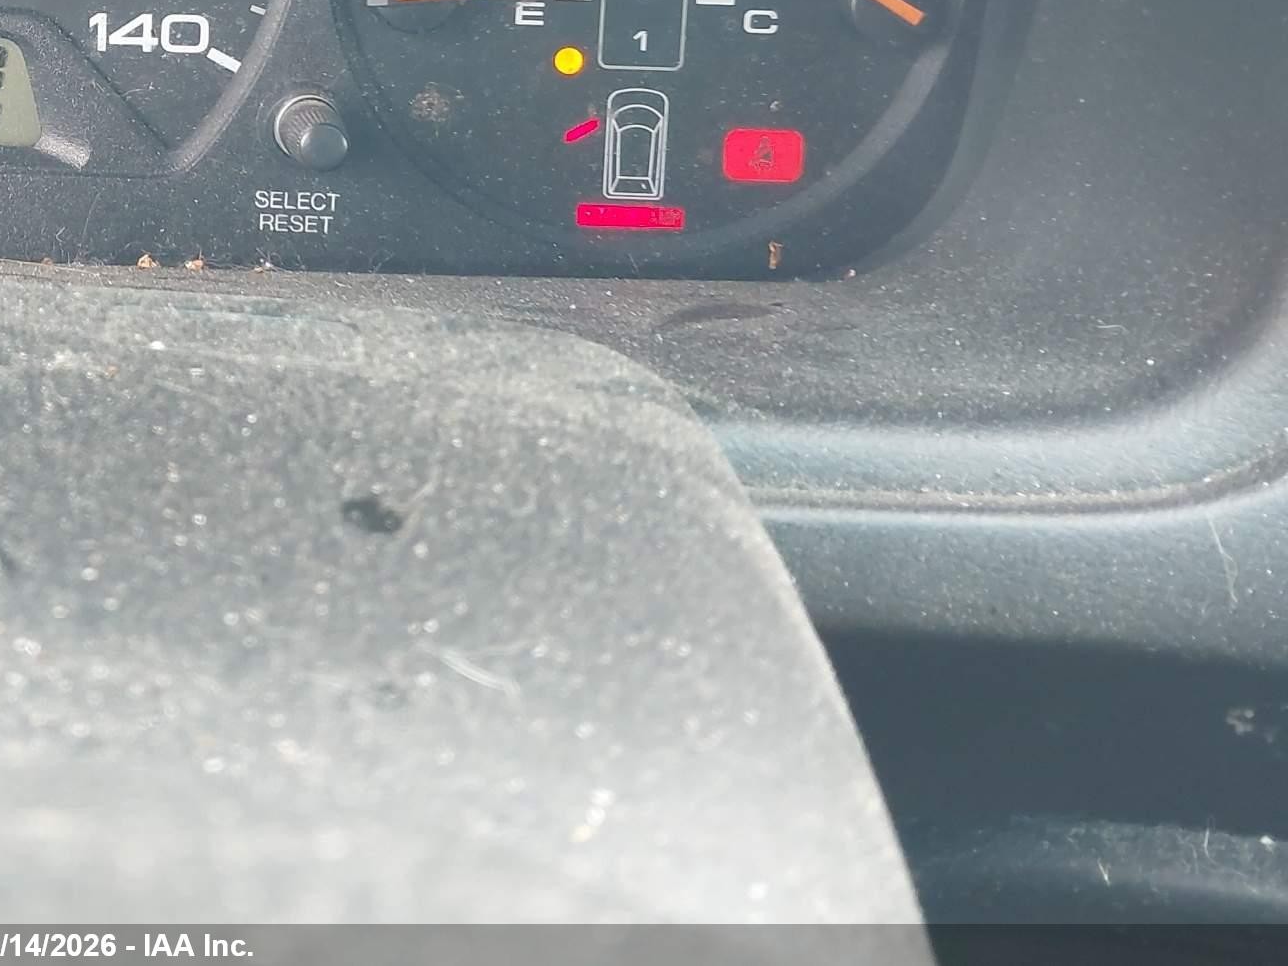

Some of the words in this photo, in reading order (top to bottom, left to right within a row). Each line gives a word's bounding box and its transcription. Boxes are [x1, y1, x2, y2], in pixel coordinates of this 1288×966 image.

[514, 2, 545, 25] E
[743, 9, 779, 35] C
[88, 12, 209, 54] 140
[632, 30, 647, 52] 1
[255, 190, 340, 212] SELECT
[259, 214, 333, 234] RESET
